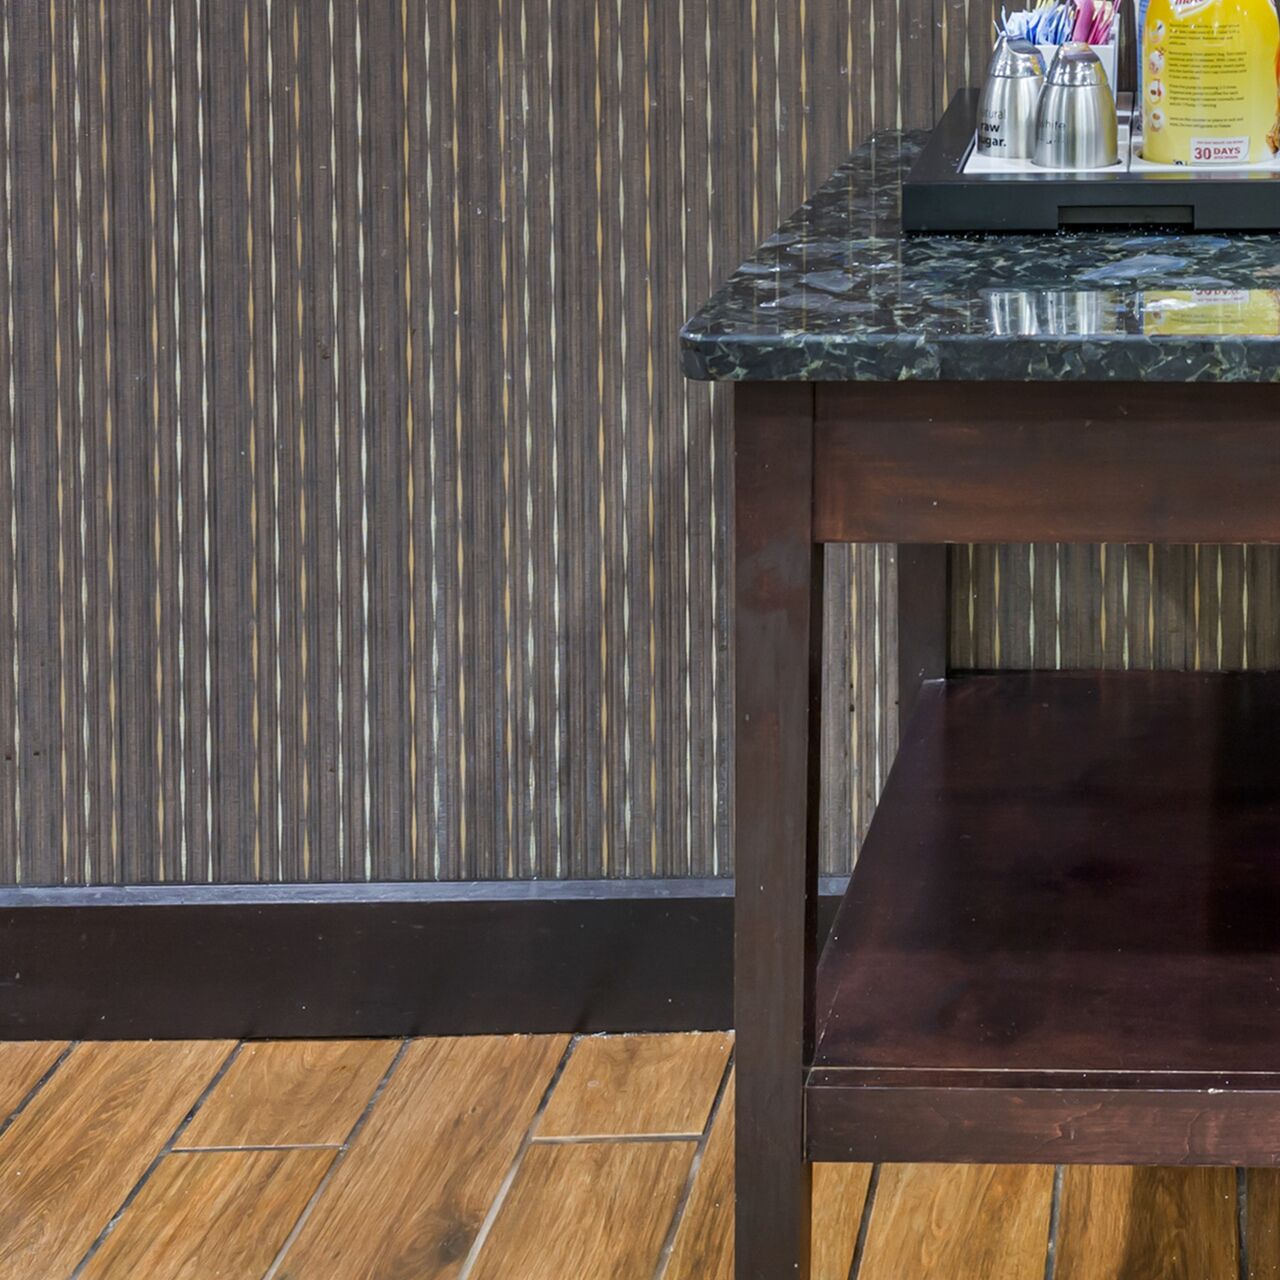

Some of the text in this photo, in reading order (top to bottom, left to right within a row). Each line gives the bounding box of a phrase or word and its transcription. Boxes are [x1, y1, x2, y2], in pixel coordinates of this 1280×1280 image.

[980, 122, 1000, 133] raw
[1194, 147, 1212, 160] 30
[1214, 146, 1241, 155] DAYS
